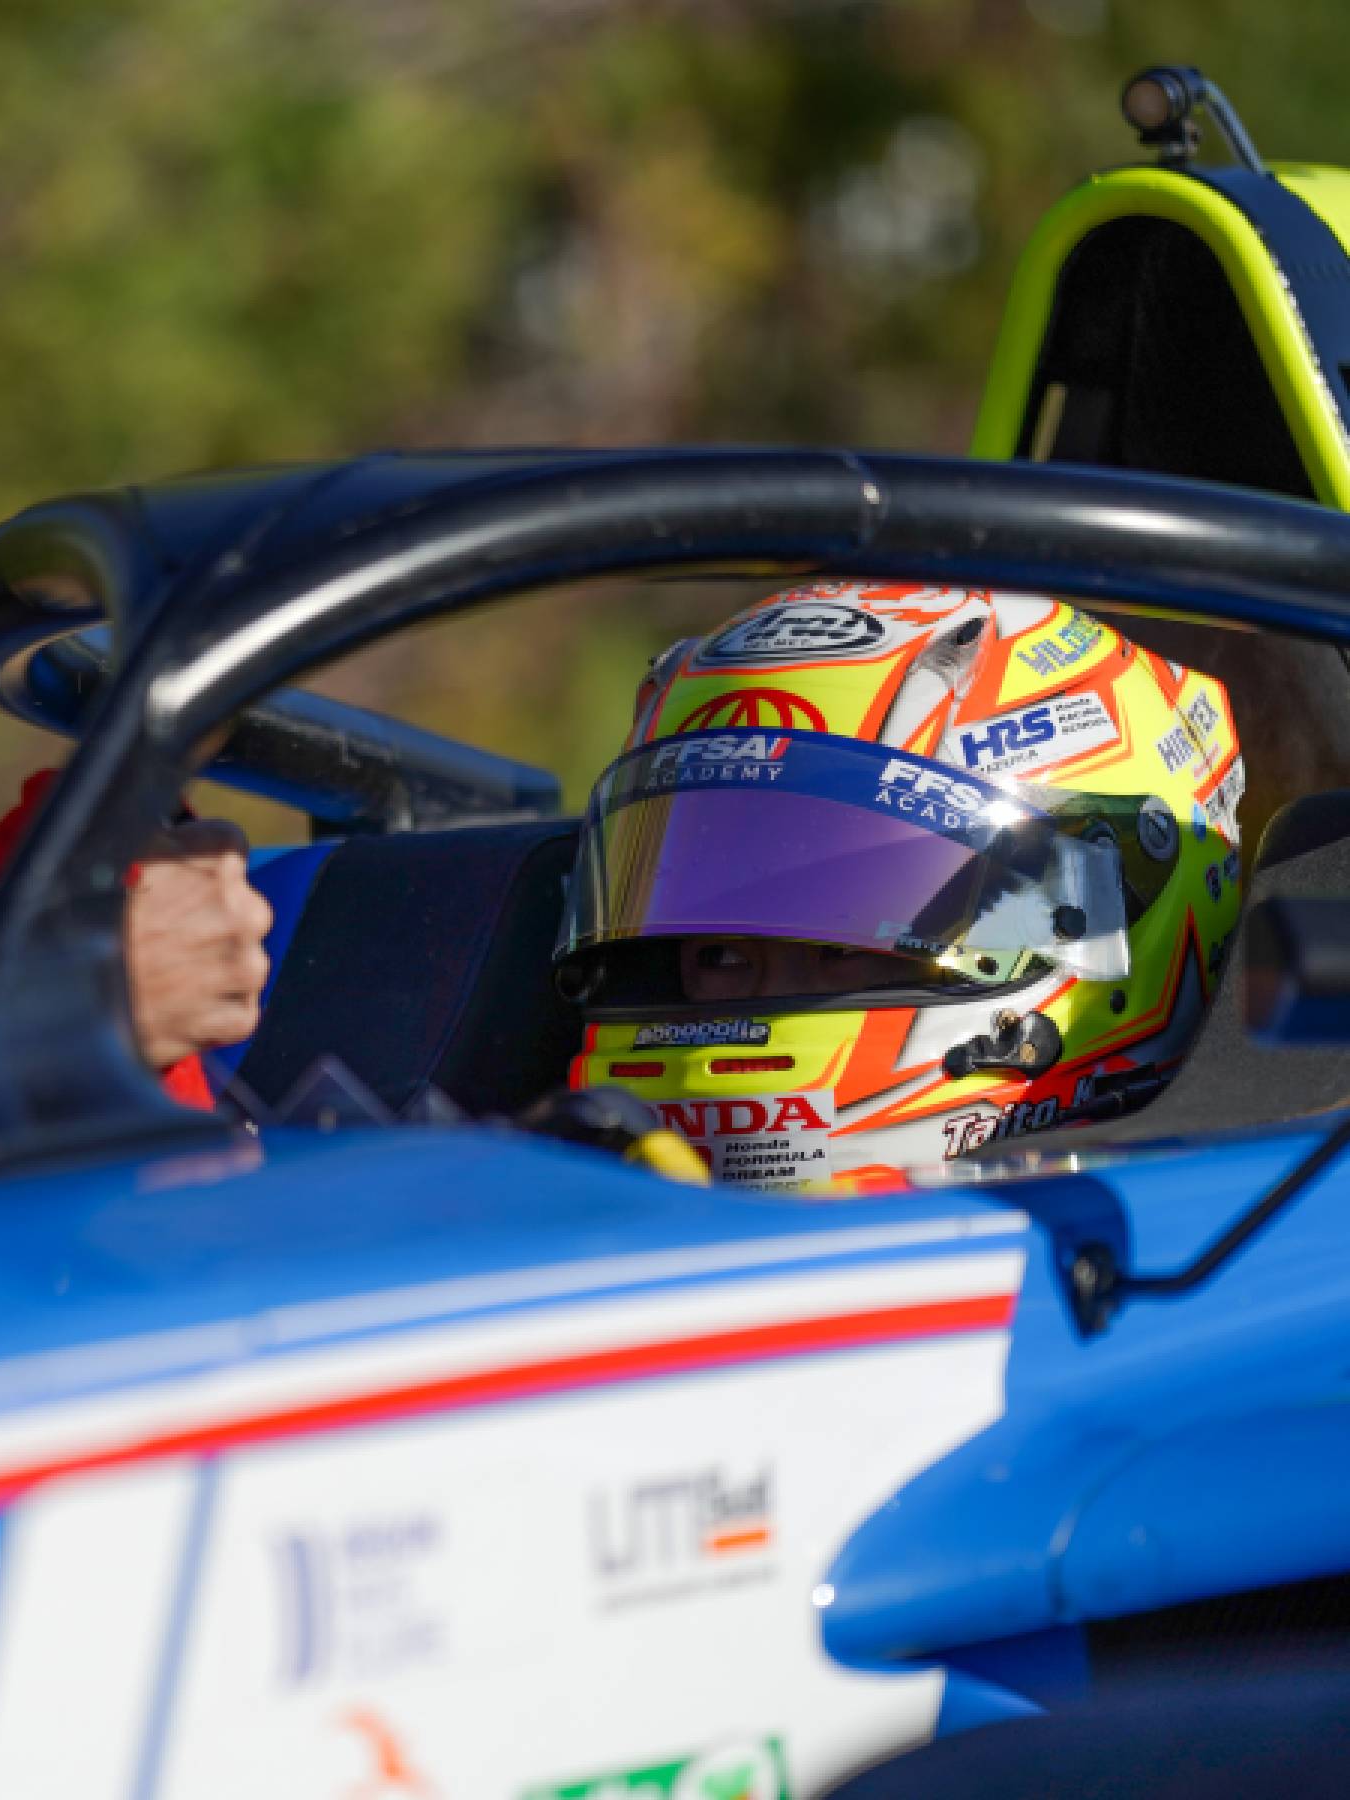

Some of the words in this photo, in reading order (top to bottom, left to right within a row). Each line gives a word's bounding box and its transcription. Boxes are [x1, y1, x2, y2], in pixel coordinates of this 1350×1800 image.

[960, 706, 1056, 768] HRS
[645, 762, 784, 790] ACADEMY
[880, 757, 984, 812] FFS
[657, 1095, 831, 1138] NDA
[723, 1148, 826, 1167] FORMULA
[725, 1139, 790, 1153] Honda
[722, 1166, 796, 1181] DREAM
